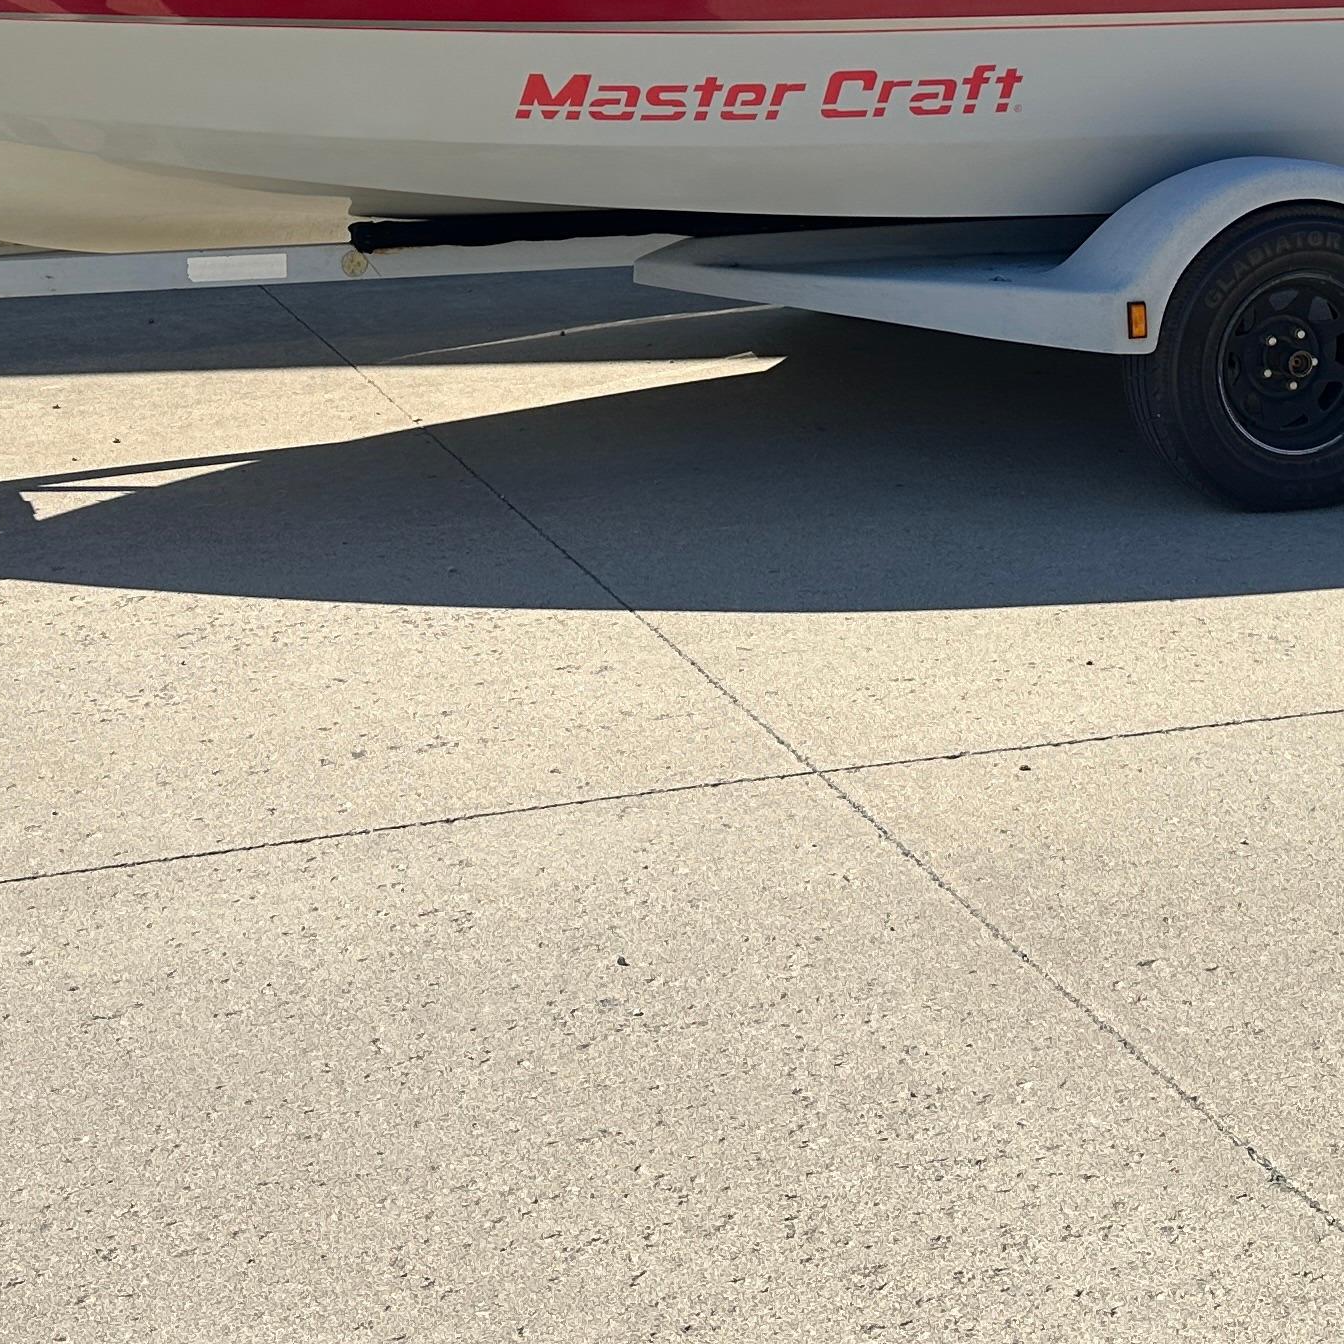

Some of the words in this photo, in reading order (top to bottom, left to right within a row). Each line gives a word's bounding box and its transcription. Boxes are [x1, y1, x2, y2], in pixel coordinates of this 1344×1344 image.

[514, 71, 808, 123] Master
[819, 63, 1024, 120] Craft
[1203, 230, 1344, 310] GLADIATOR
